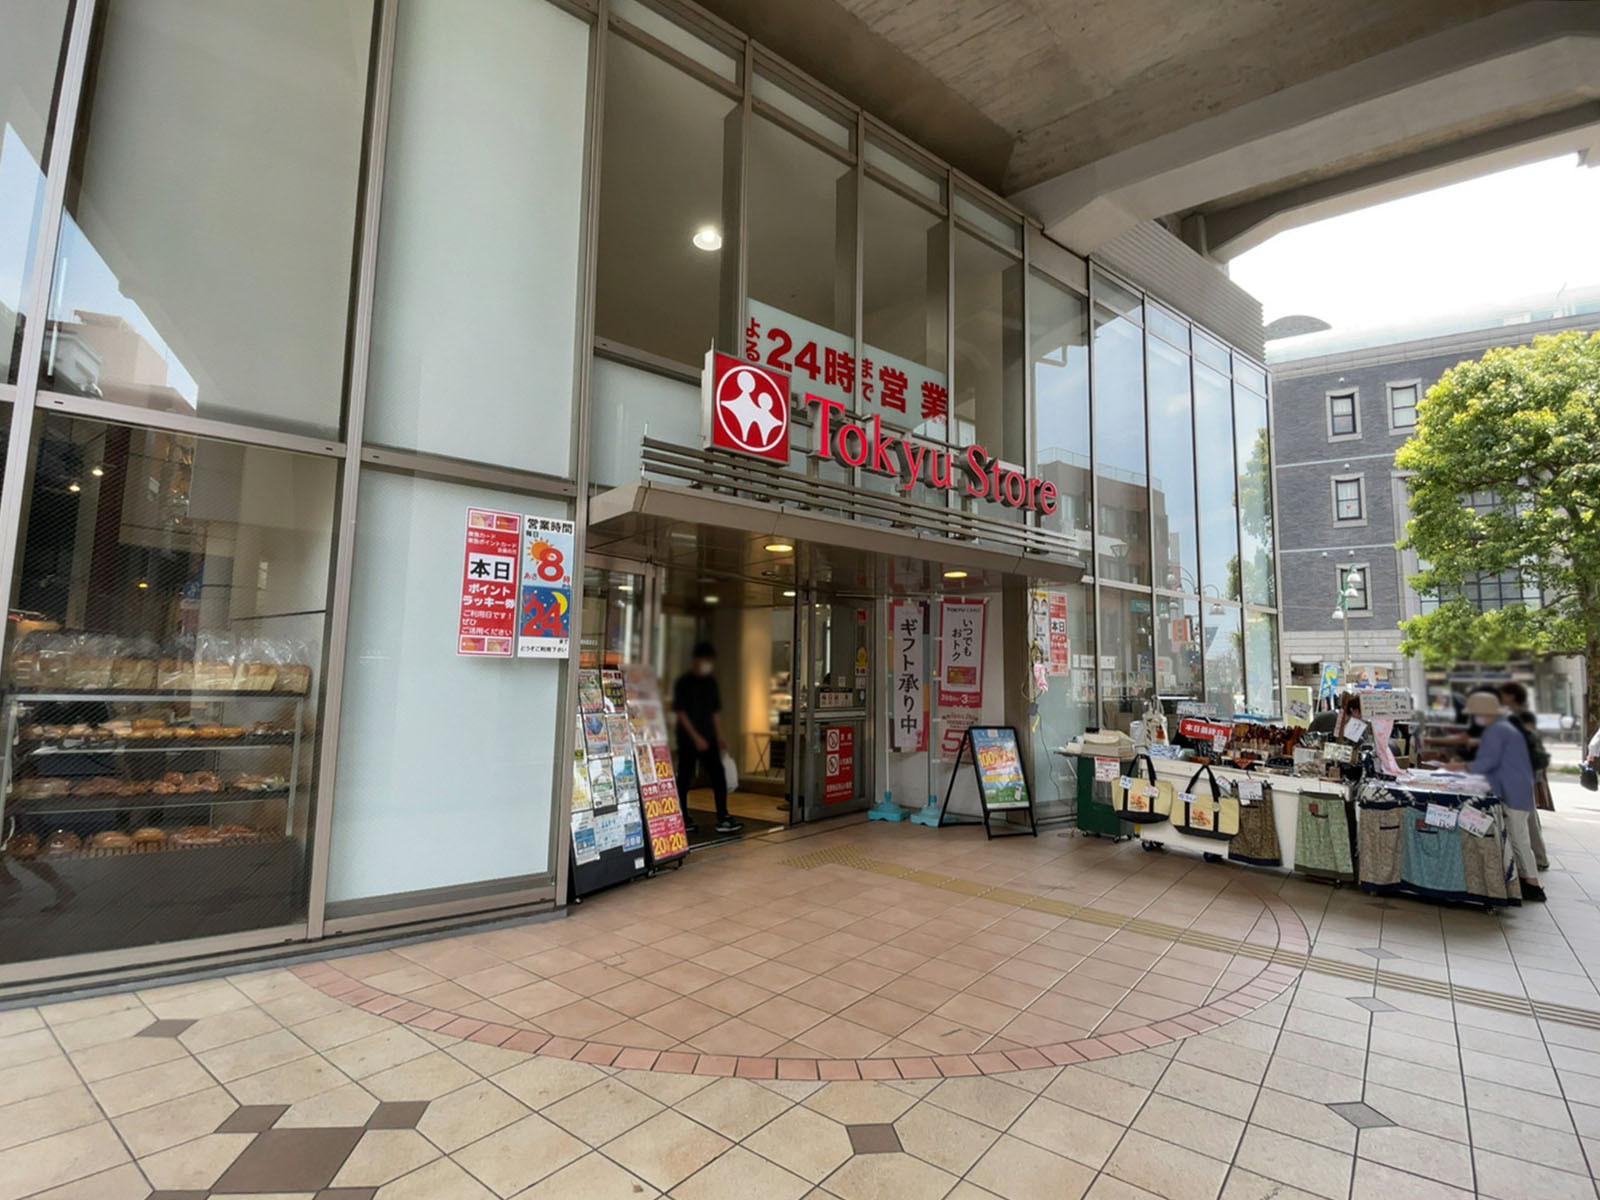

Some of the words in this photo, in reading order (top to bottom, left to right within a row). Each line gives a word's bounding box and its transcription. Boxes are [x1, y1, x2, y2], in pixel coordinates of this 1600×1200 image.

[804, 392, 952, 490] Tokyu
[965, 444, 1058, 514] Store
[527, 518, 573, 535] 営業時間
[470, 558, 510, 580] 本日
[537, 547, 564, 582] 8
[468, 583, 511, 597] ポイント
[522, 600, 563, 636] 24
[952, 628, 962, 662] おトク
[963, 619, 973, 657] いつでも
[898, 619, 920, 735] ギフト承り中
